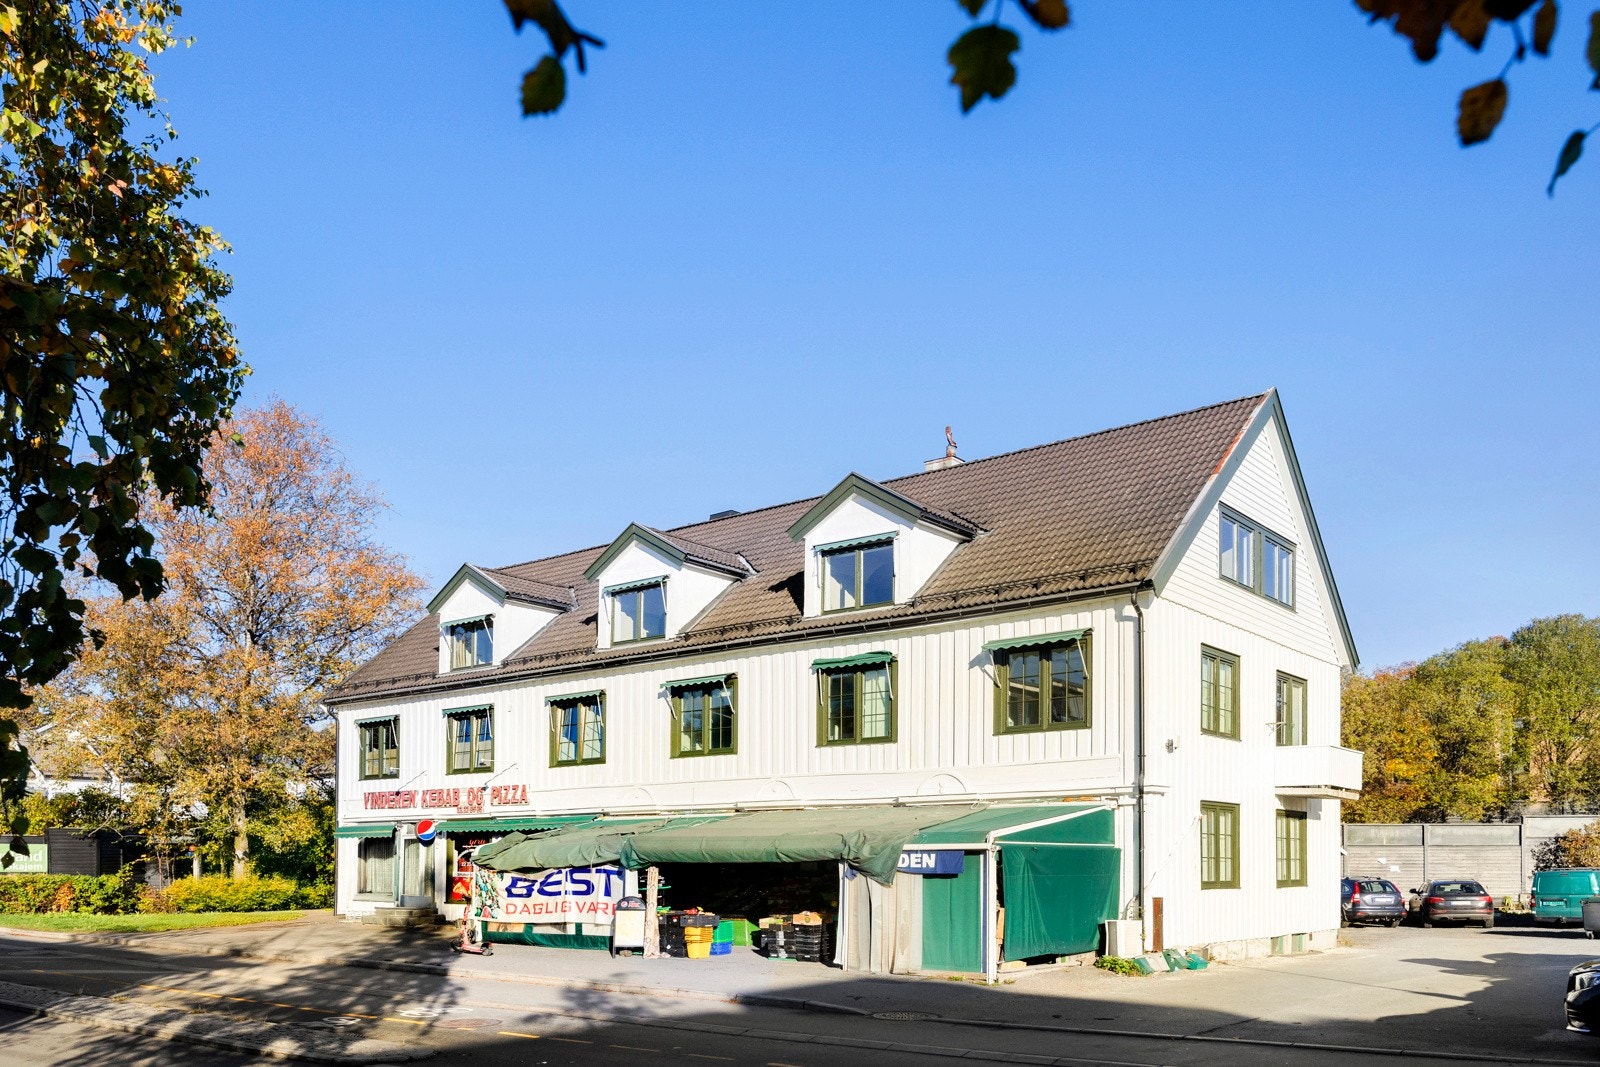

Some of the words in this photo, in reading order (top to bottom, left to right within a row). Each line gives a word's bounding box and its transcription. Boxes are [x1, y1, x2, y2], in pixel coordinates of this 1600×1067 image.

[421, 788, 460, 808] KEBAB
[467, 787, 484, 806] OG
[490, 784, 527, 805] PIZZA
[898, 853, 936, 868] DEN
[505, 868, 625, 898] BEST
